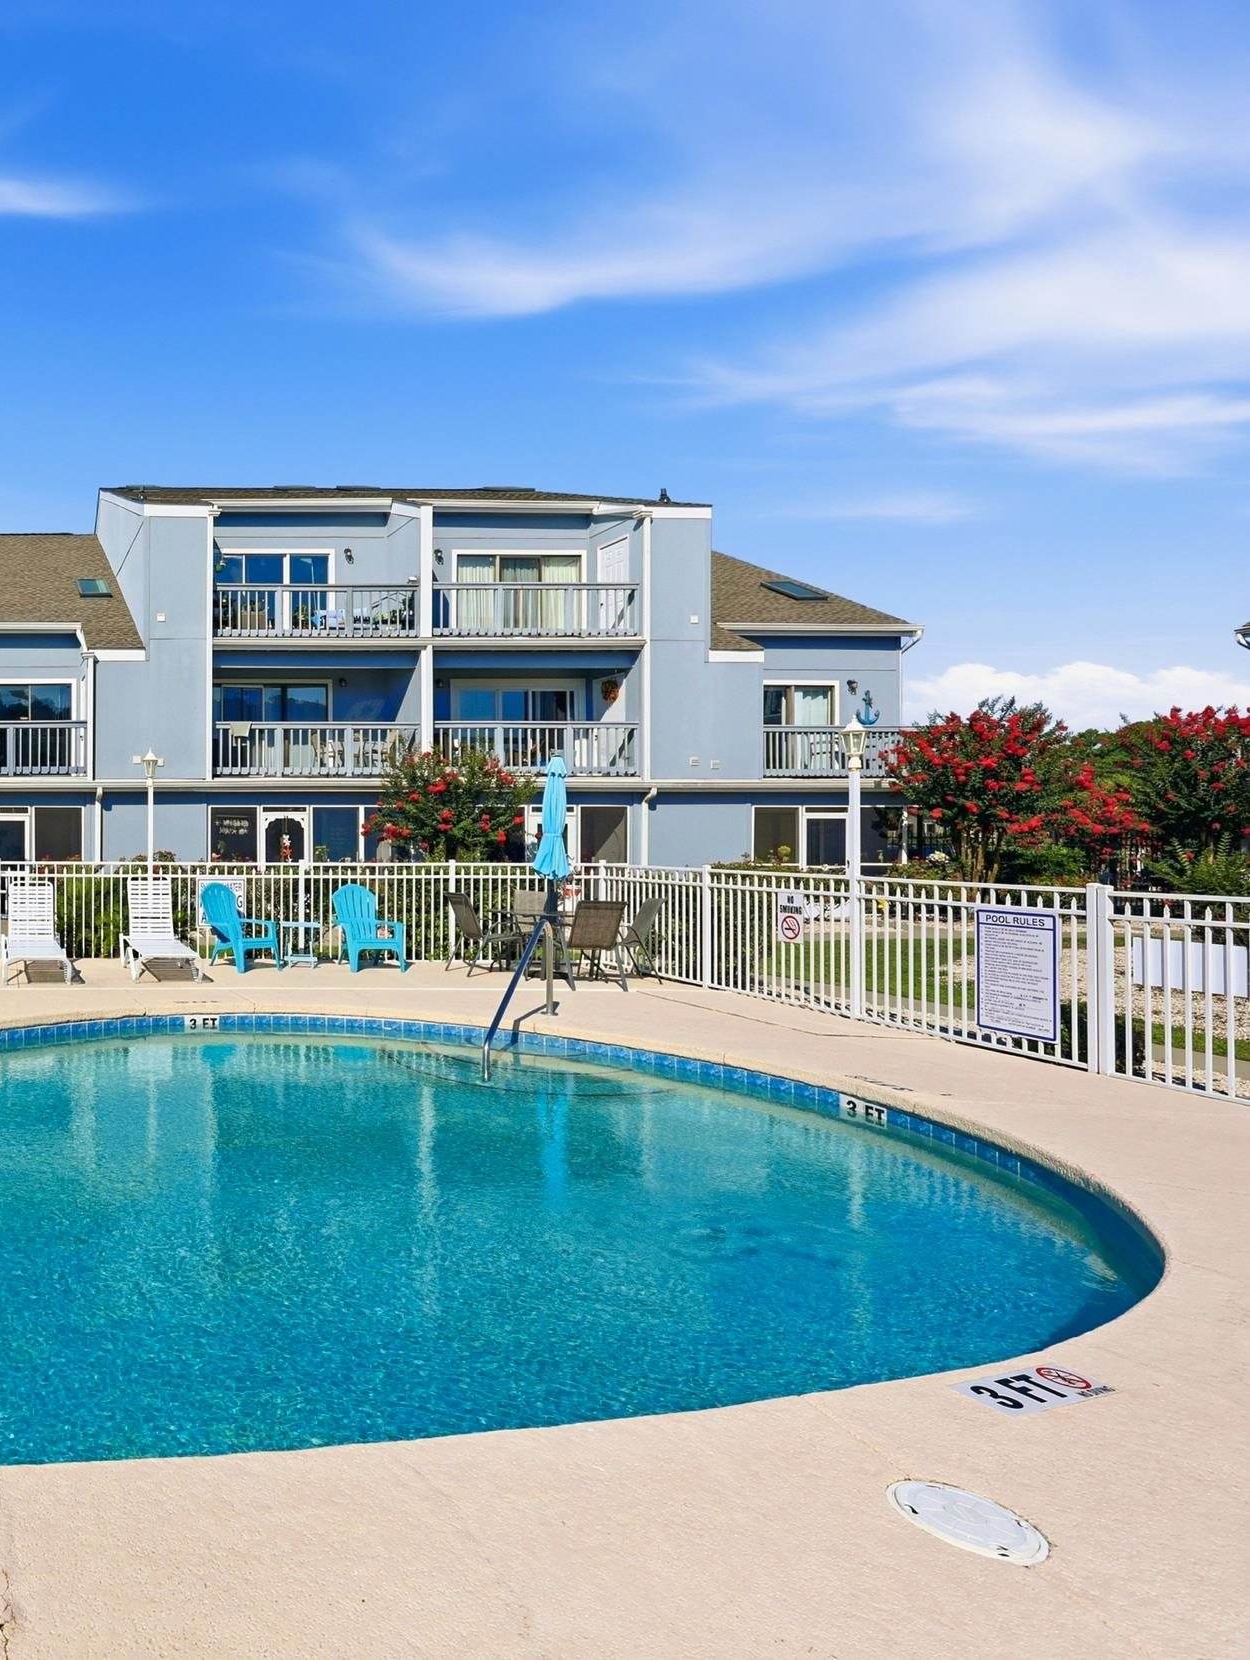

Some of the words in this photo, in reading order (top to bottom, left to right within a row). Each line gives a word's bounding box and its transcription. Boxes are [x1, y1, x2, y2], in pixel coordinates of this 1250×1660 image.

[787, 895, 794, 904] NO
[779, 904, 803, 915] SMOKING
[985, 914, 1010, 924] POOL
[1013, 916, 1045, 927] RULES
[993, 1374, 1068, 1404] FT
[970, 1385, 1024, 1409] 3
